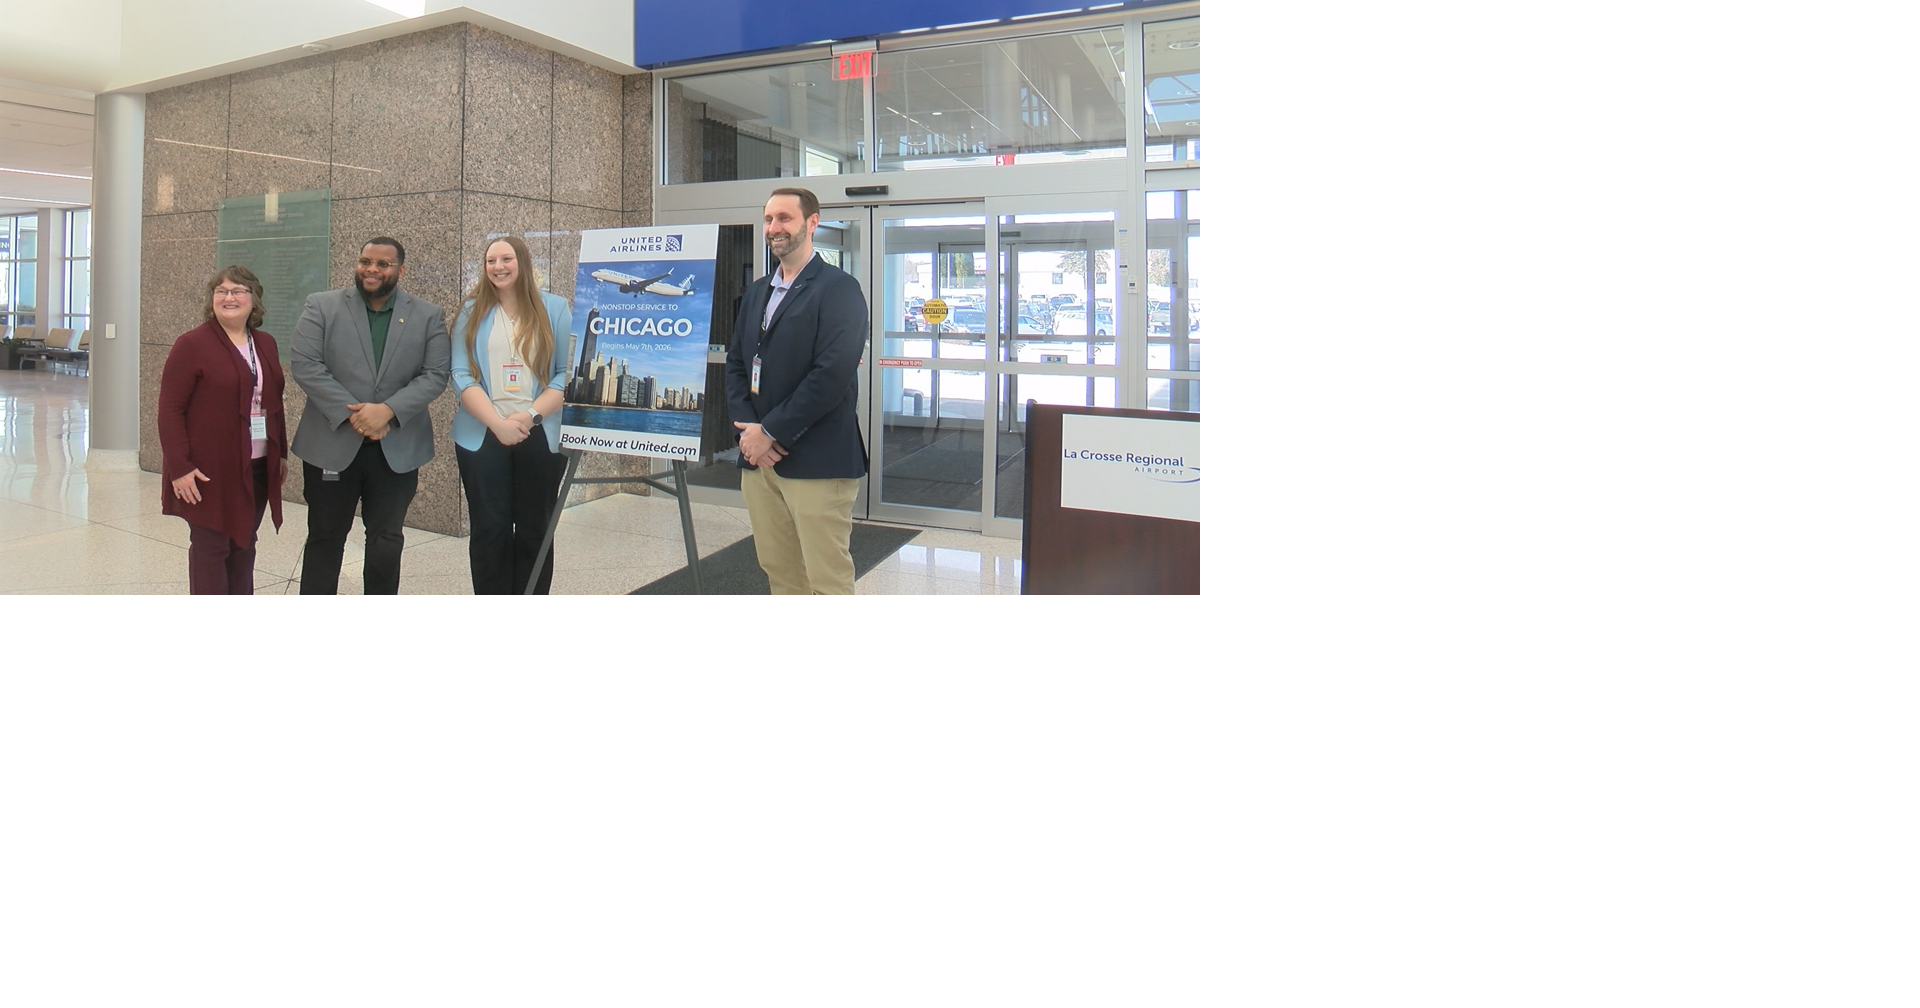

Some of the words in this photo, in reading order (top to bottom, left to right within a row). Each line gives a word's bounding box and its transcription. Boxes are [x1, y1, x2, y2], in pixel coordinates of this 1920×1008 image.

[839, 52, 872, 80] EXIT
[621, 236, 662, 244] UNITED
[609, 244, 662, 253] AIRLINES
[601, 303, 636, 311] NONSTOP
[590, 317, 692, 336] CHICAGO
[602, 342, 624, 350] Begins
[625, 343, 640, 351] May
[641, 343, 653, 351] 7th,
[561, 434, 587, 444] Book
[589, 436, 614, 448] Now
[616, 440, 628, 449] at
[630, 440, 697, 456] United.com
[1064, 448, 1077, 459] La
[1080, 449, 1122, 462] Crosse
[1126, 452, 1184, 467] Regional
[1134, 466, 1184, 476] AIRPORT
